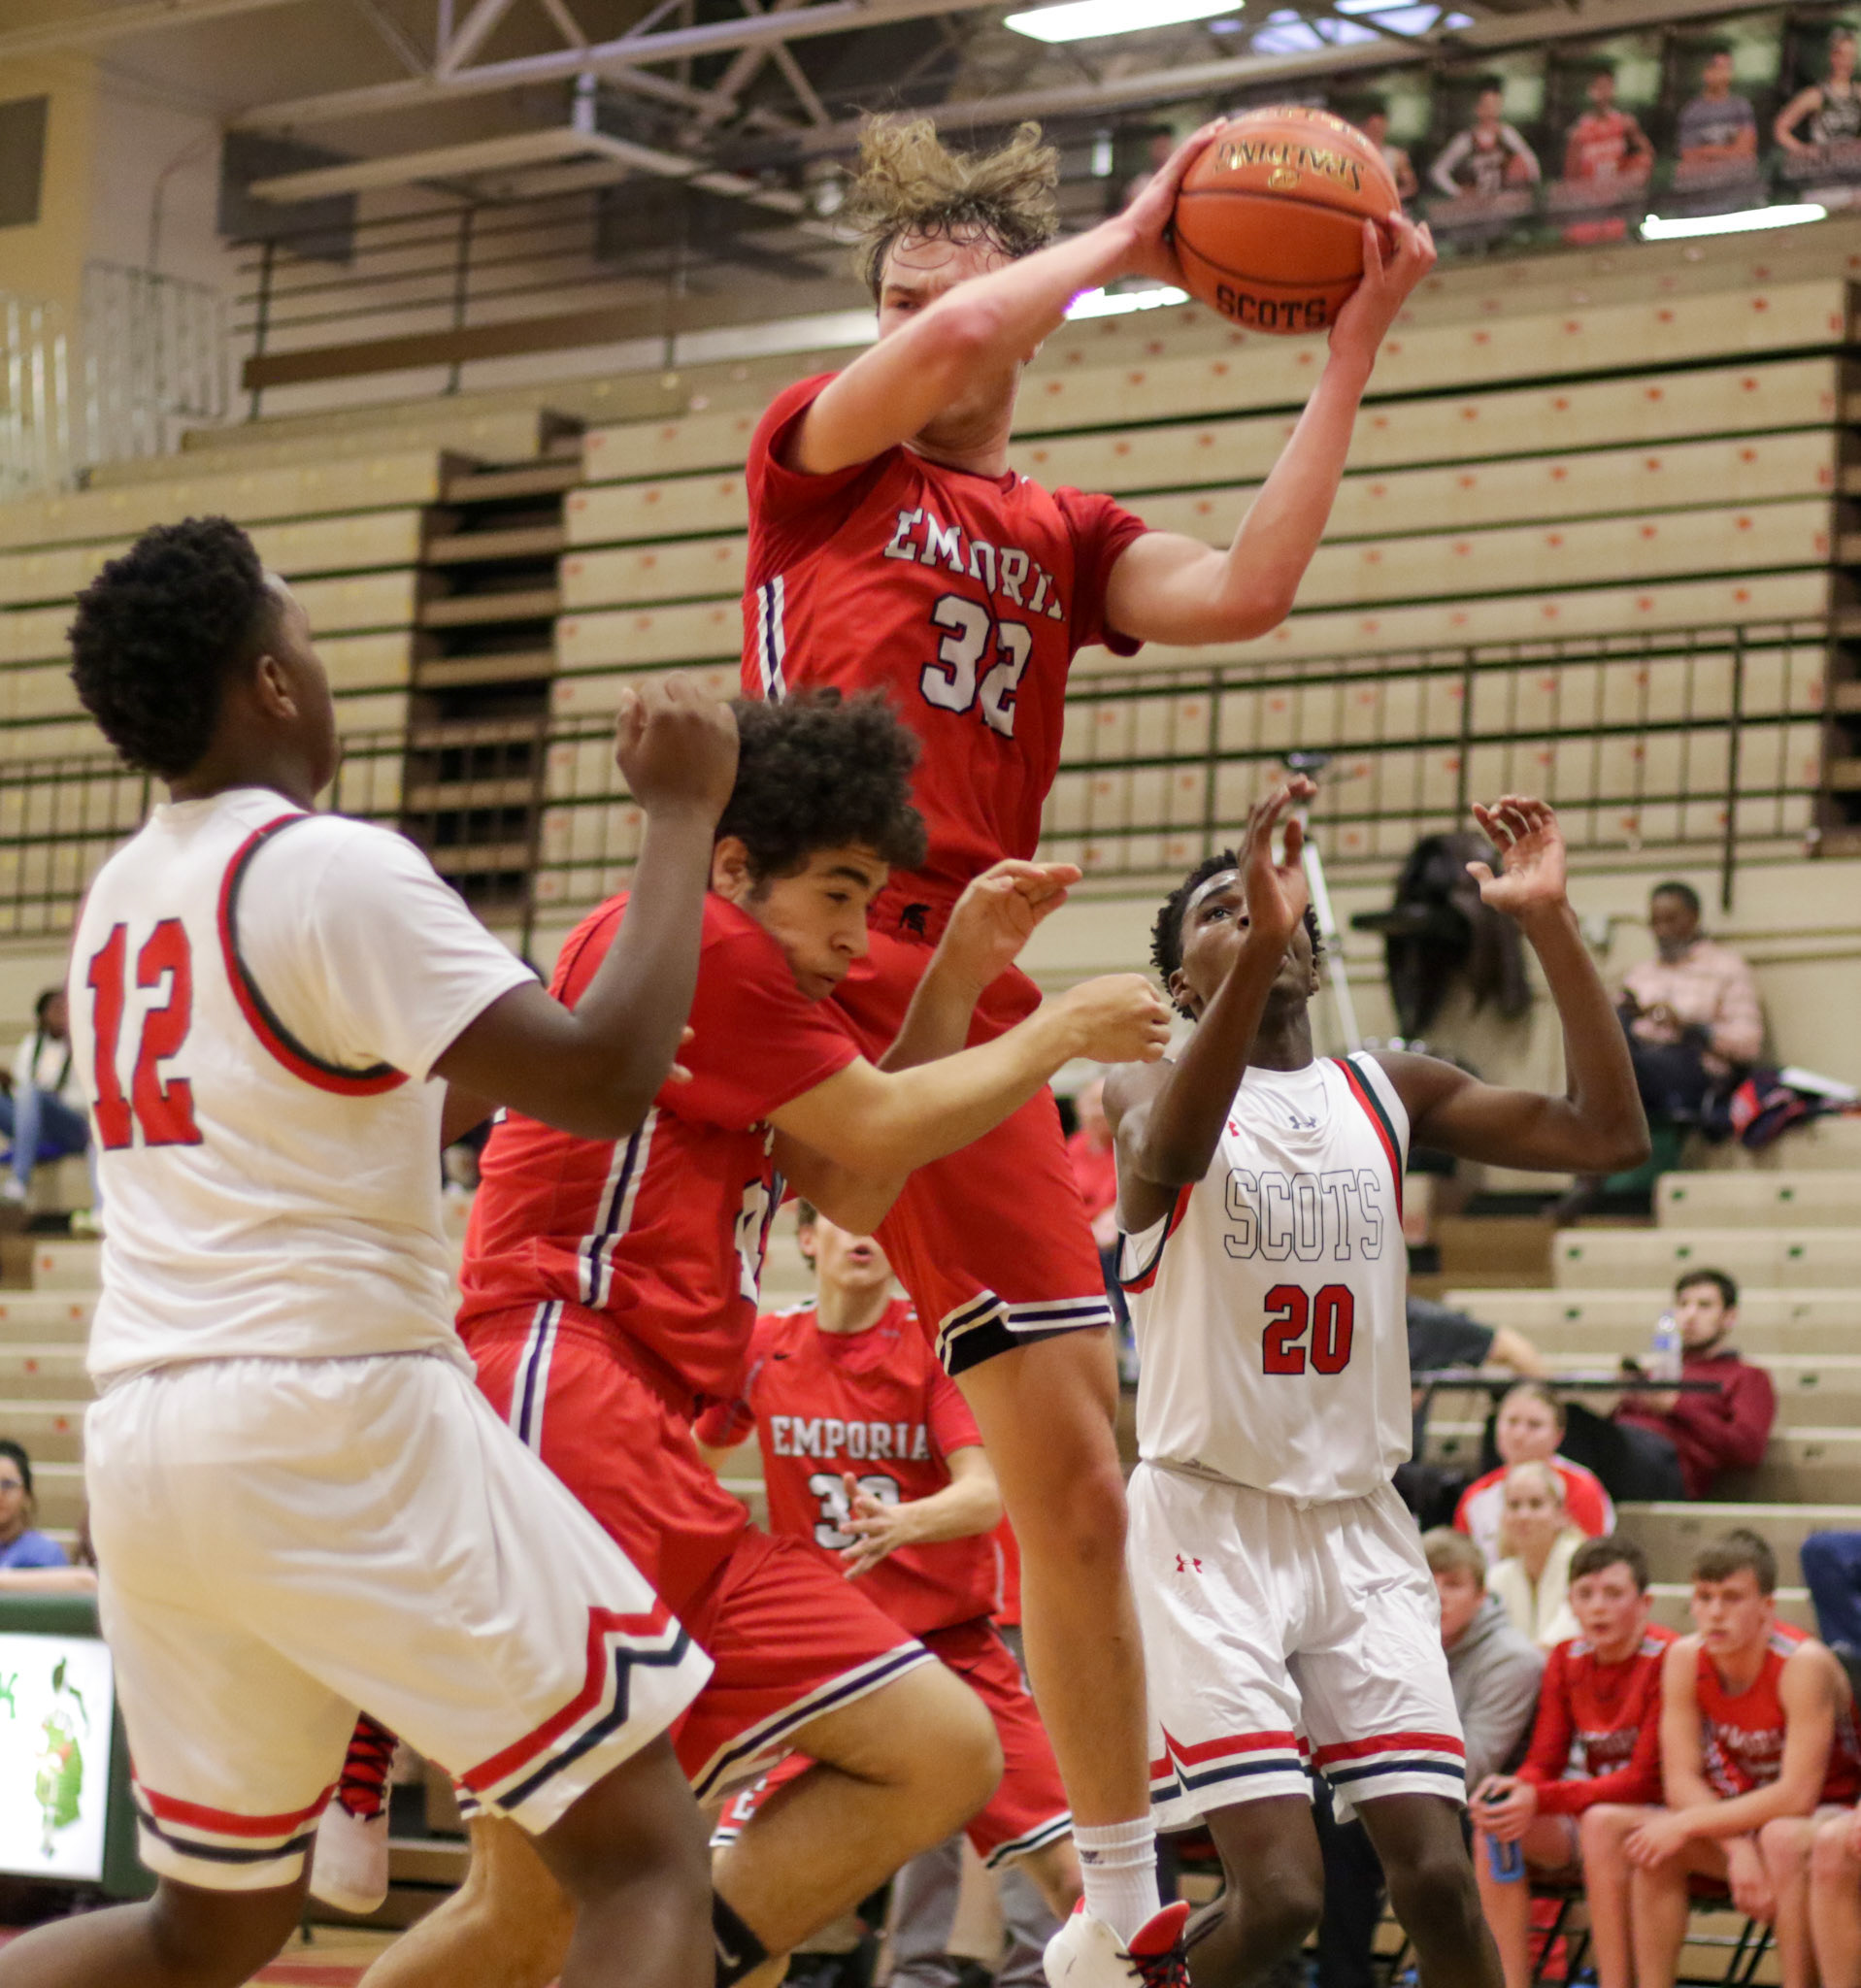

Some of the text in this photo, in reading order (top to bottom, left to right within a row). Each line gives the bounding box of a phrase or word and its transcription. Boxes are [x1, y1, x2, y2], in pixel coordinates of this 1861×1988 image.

[1216, 284, 1327, 328] SCOTS
[919, 593, 1032, 740] 32
[86, 916, 204, 1150] 12
[1224, 1168, 1383, 1261] SCOTS
[1263, 1284, 1354, 1375] 20
[771, 1414, 928, 1461] EMPORIA
